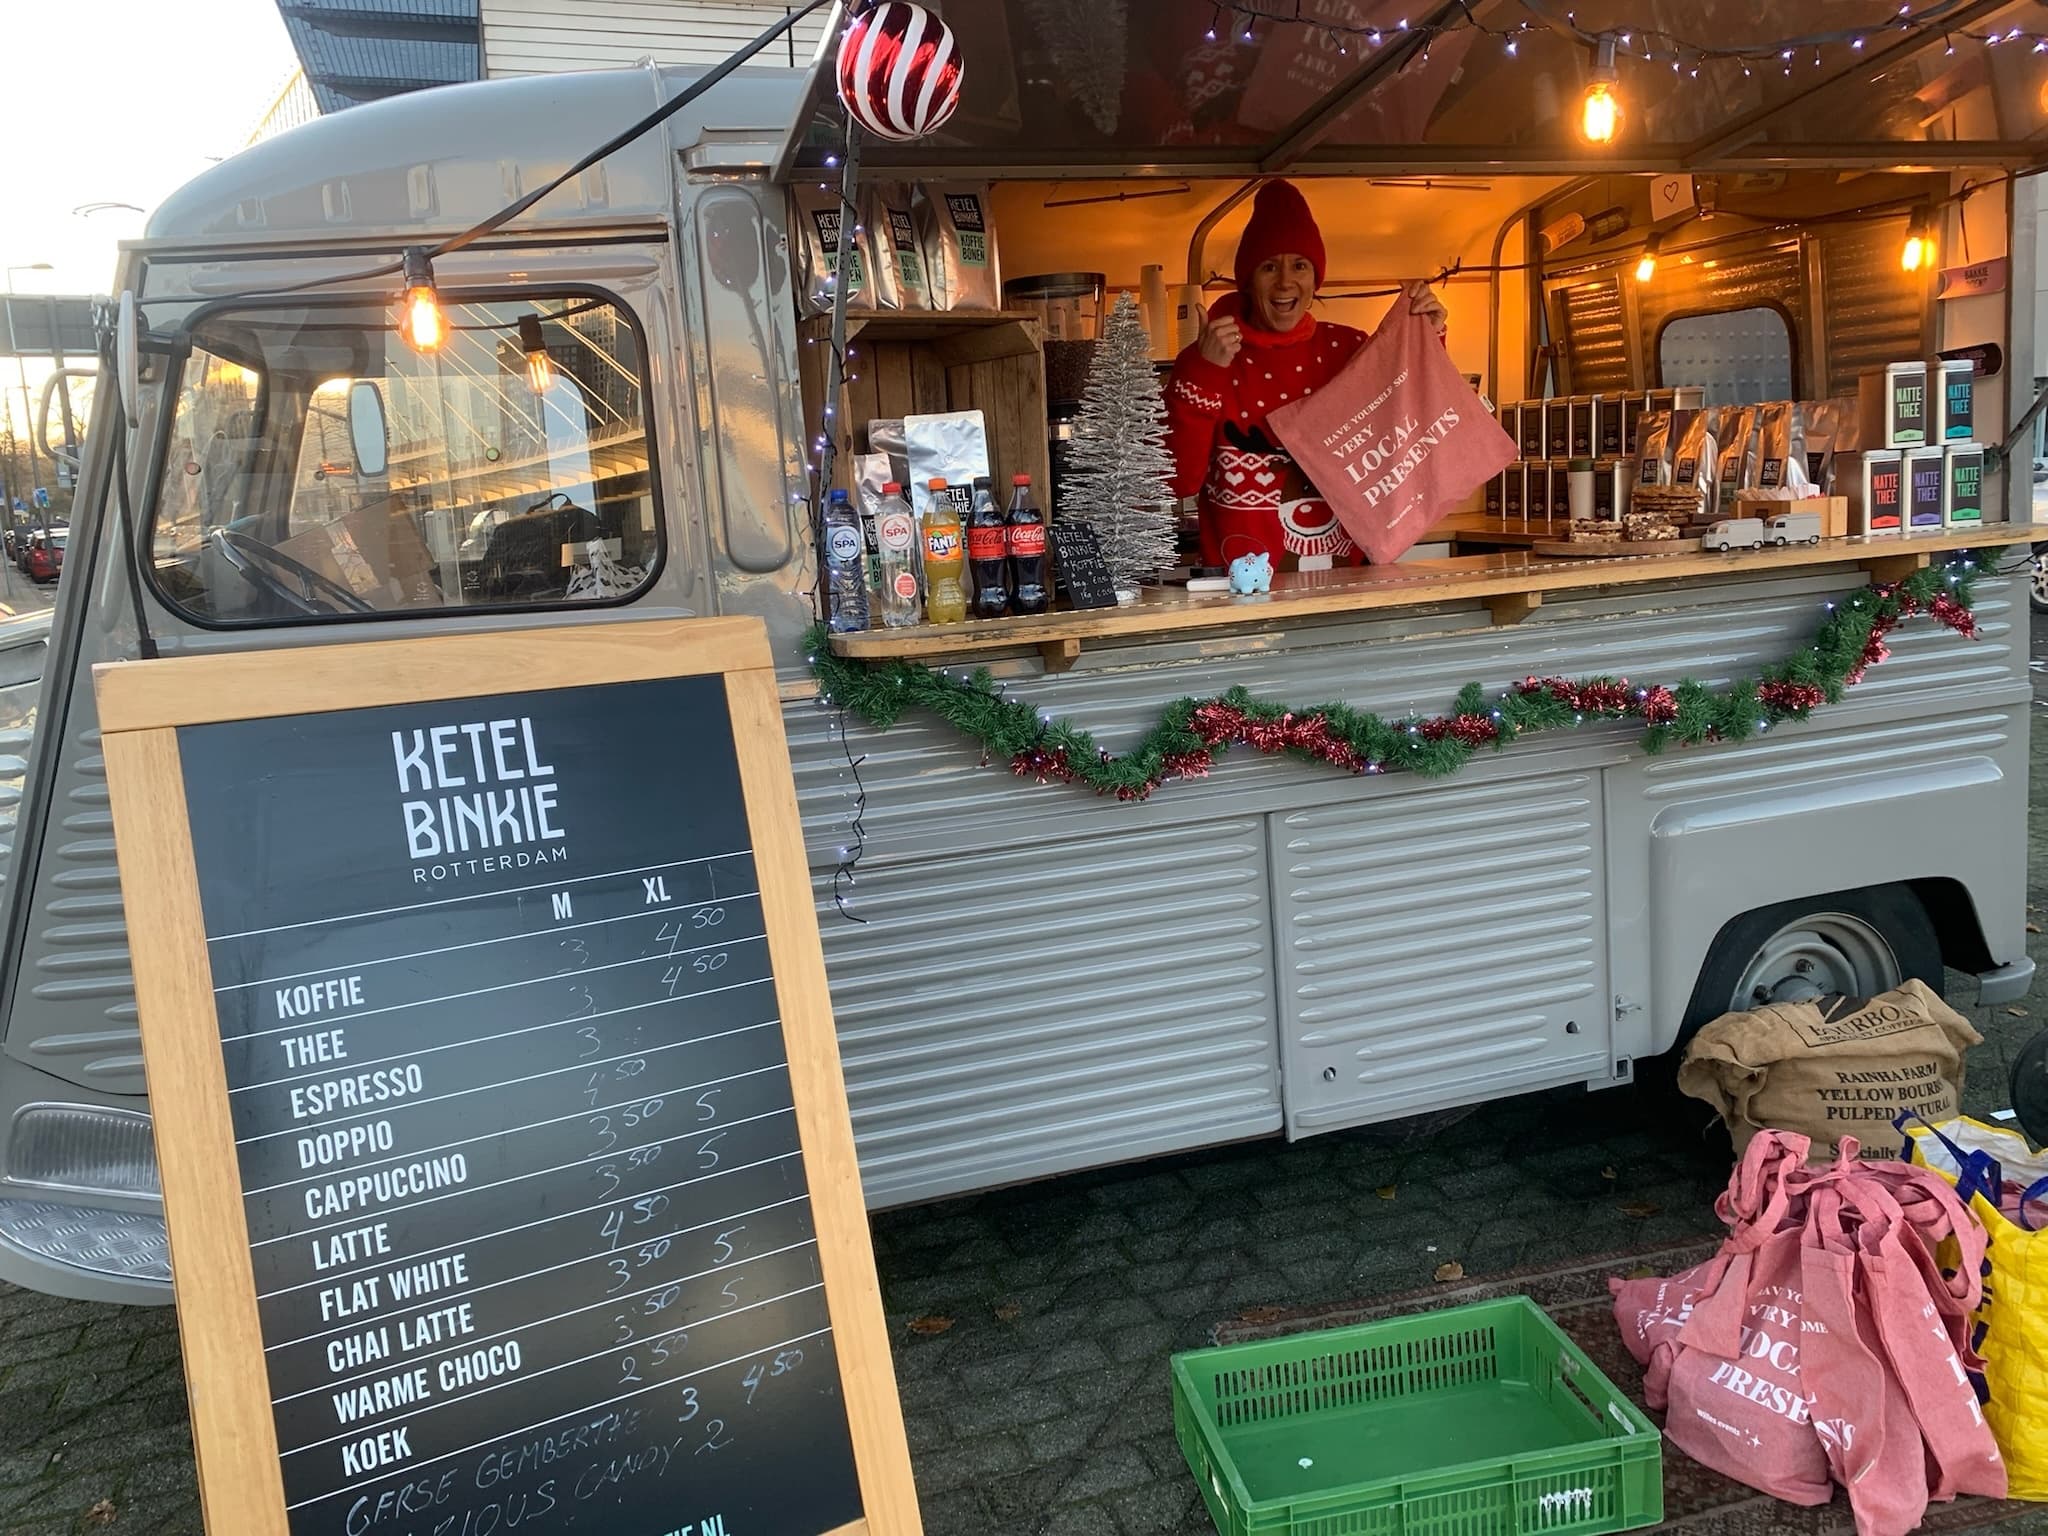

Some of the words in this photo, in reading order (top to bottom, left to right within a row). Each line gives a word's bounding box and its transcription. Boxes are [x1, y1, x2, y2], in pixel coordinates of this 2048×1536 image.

[817, 213, 841, 229] KETE
[948, 198, 977, 211] KETEL
[1896, 386, 1922, 403] NATTE
[1948, 384, 1971, 400] NATTE
[1950, 399, 1969, 414] THEE
[1323, 422, 1352, 447] HAVE
[1350, 385, 1393, 424] YOURSELF
[1898, 402, 1921, 418] THEE
[1332, 423, 1375, 460] VERY
[1344, 413, 1419, 486] LOCAL
[1361, 406, 1462, 509] PRESENTS
[1873, 473, 1899, 489] NATTE
[1914, 471, 1940, 487] NATTE
[1954, 466, 1980, 482] NATTE
[1956, 482, 1978, 497] THEE
[1876, 489, 1897, 505] THEE
[1917, 486, 1938, 502] THEE
[834, 539, 856, 549] SPA
[885, 527, 908, 537] SPA
[1055, 531, 1089, 543] KETEL
[392, 717, 555, 793] KETEL
[402, 783, 566, 859] BINKIE
[413, 846, 568, 883] ROTTERDAM
[551, 891, 573, 920] M
[642, 876, 672, 904] XL
[275, 975, 365, 1019] KOFFIE
[280, 1029, 348, 1068] THEE
[576, 1026, 601, 1058] 3
[1835, 1070, 1903, 1083] RAINHA
[1901, 1062, 1938, 1080] FARM
[290, 1063, 423, 1119] ESPRESSO
[695, 1089, 722, 1121] 5
[1816, 1088, 1894, 1102] YELLOW
[1826, 1106, 1897, 1120] PULPED
[297, 1120, 393, 1169] DOPPIO
[696, 1132, 727, 1169] 5
[1829, 1143, 1897, 1161] Scially
[304, 1153, 468, 1219] CAPPUCCINO
[312, 1222, 391, 1270] LATTE
[713, 1226, 746, 1263] 5
[319, 1277, 380, 1322] FLAT
[388, 1253, 469, 1301] WHITE
[719, 1277, 745, 1308] 5
[326, 1327, 391, 1373] CHAI
[399, 1303, 475, 1351] LATTE
[332, 1368, 431, 1424] WARME
[438, 1340, 522, 1392] CHOCO
[678, 1386, 700, 1422] 3
[341, 1426, 412, 1477] KOEK
[695, 1419, 735, 1456] 2
